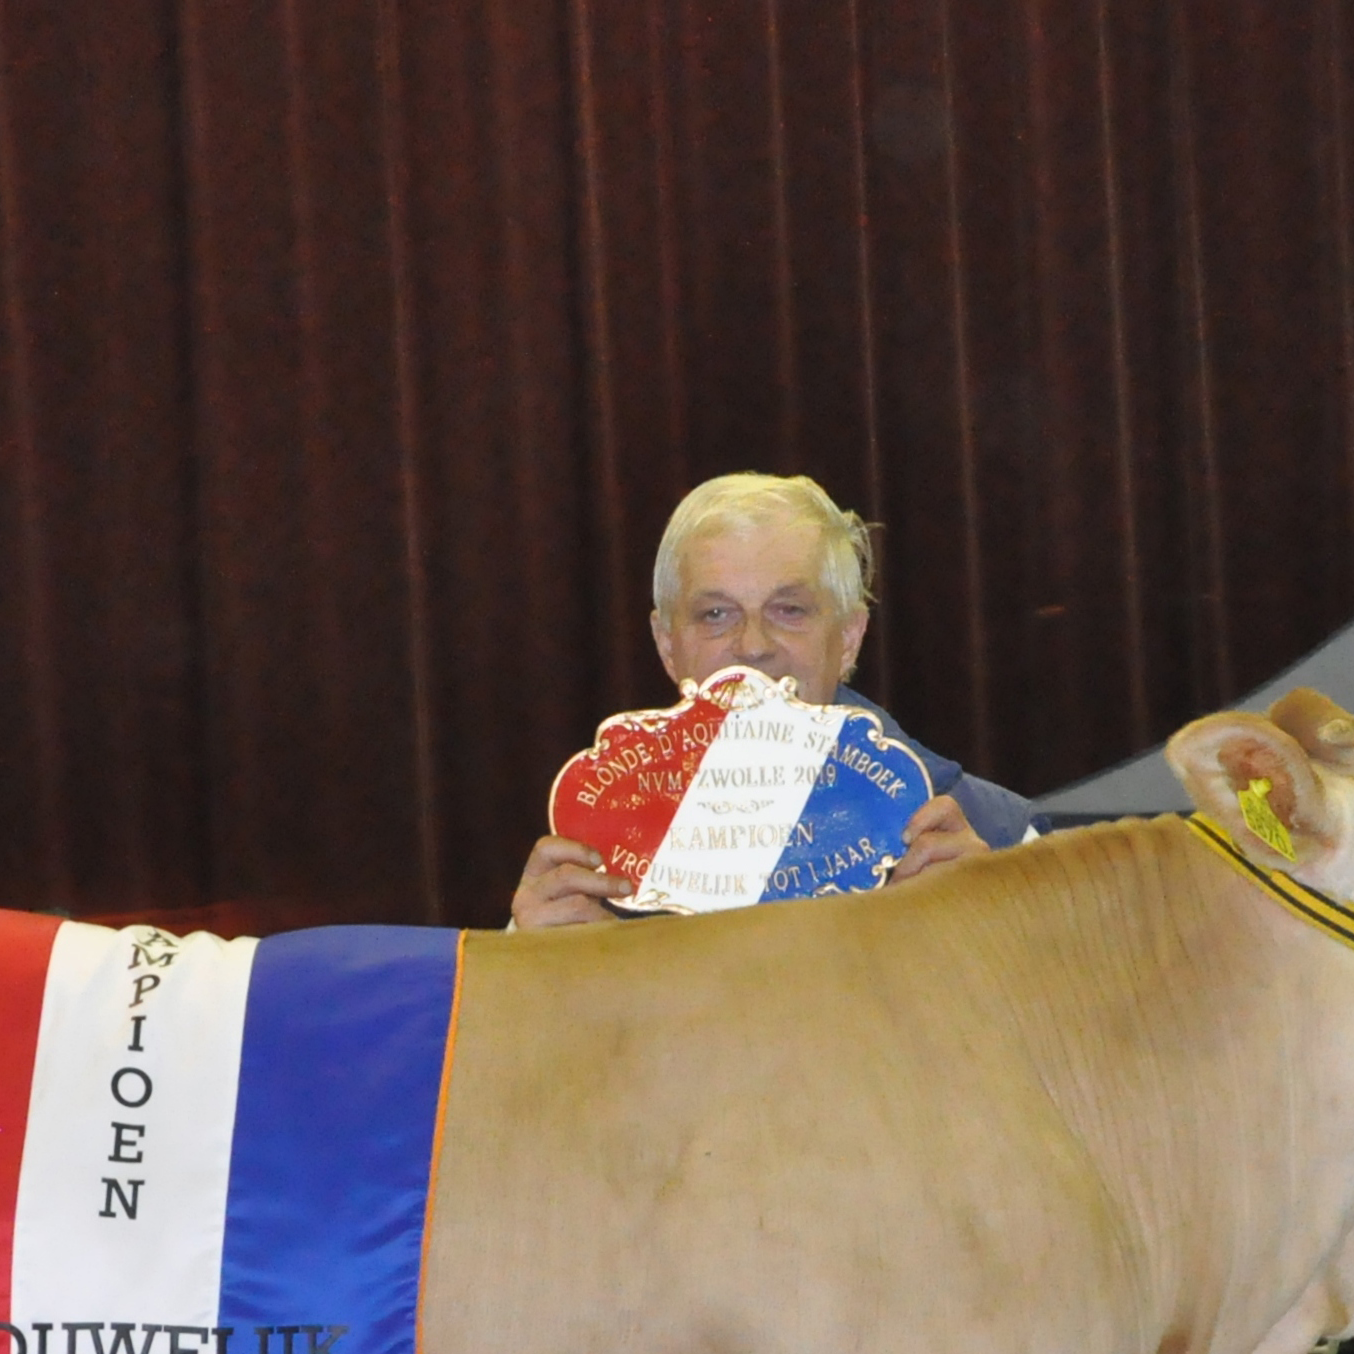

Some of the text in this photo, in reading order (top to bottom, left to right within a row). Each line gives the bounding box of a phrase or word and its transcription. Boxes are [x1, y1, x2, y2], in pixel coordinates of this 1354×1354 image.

[576, 719, 908, 809] BLONDE D'AQUITAINE STAMBOEK
[697, 765, 786, 790] ZWOLLE
[793, 763, 838, 787] 2019
[610, 844, 749, 896] VROUWELIJK
[758, 865, 802, 893] TOT
[823, 836, 877, 883] JAAR
[667, 821, 816, 851] KAMPIOEN
[99, 929, 180, 1220] AMPIOEN
